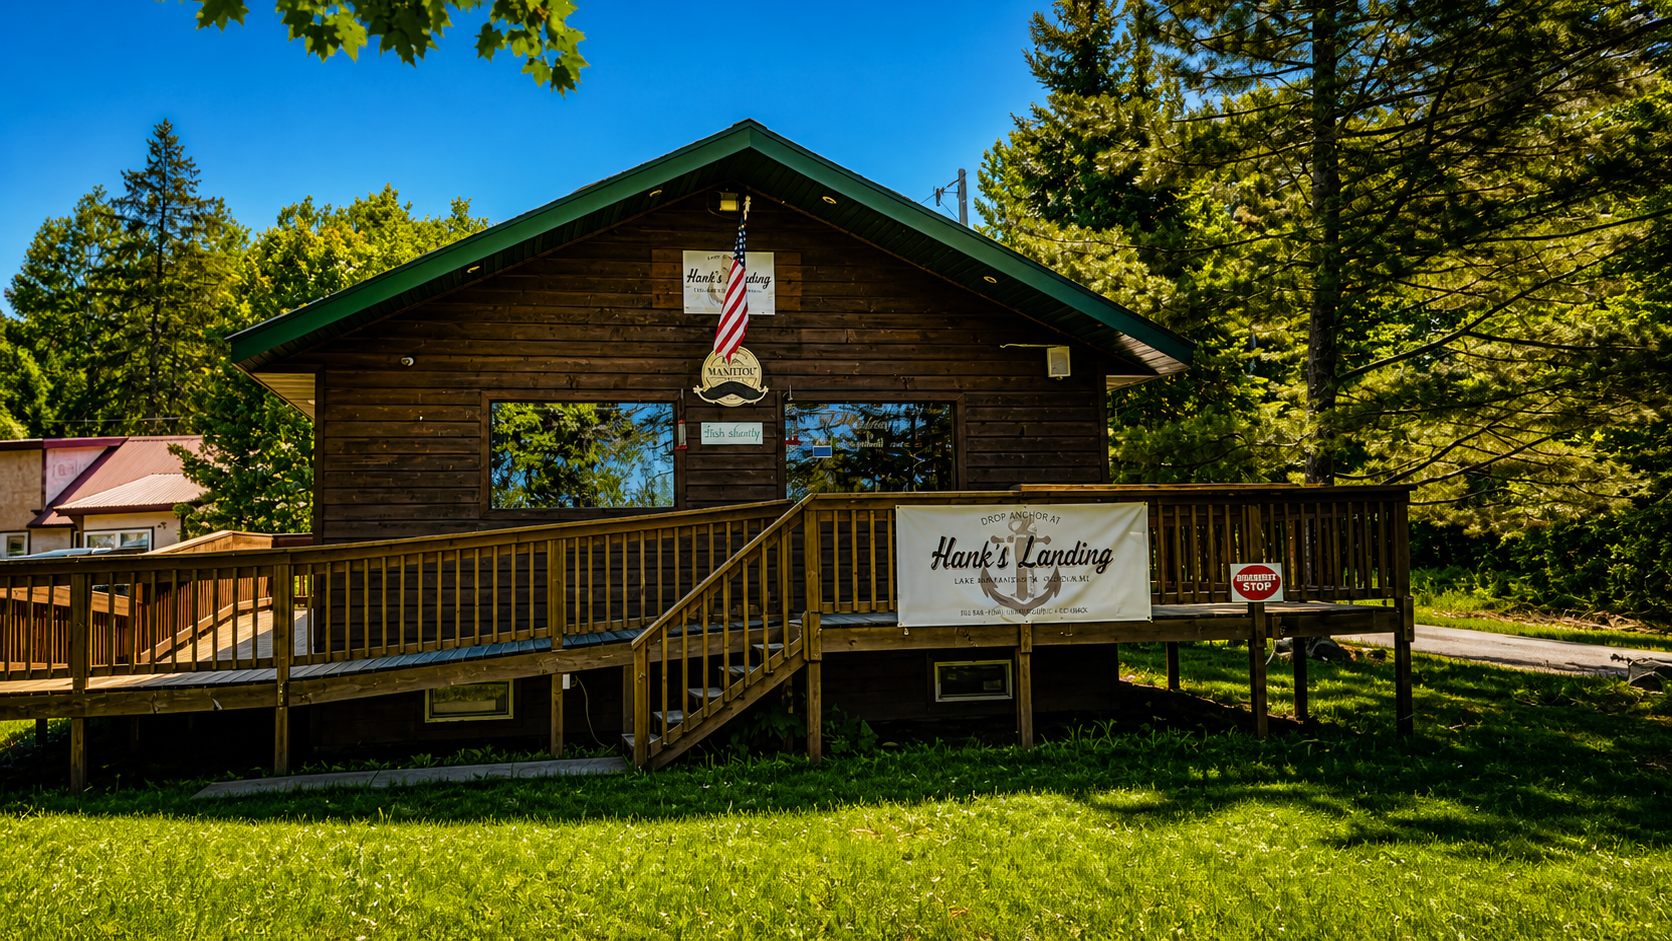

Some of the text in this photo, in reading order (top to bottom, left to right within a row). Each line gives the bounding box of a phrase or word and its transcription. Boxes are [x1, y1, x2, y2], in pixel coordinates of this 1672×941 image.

[687, 268, 722, 284] Hank's
[980, 511, 1061, 526] DROP ANCHOR AT
[931, 535, 1114, 574] Hank's Landing
[954, 577, 975, 585] LAKE
[1243, 582, 1272, 591] STOP
